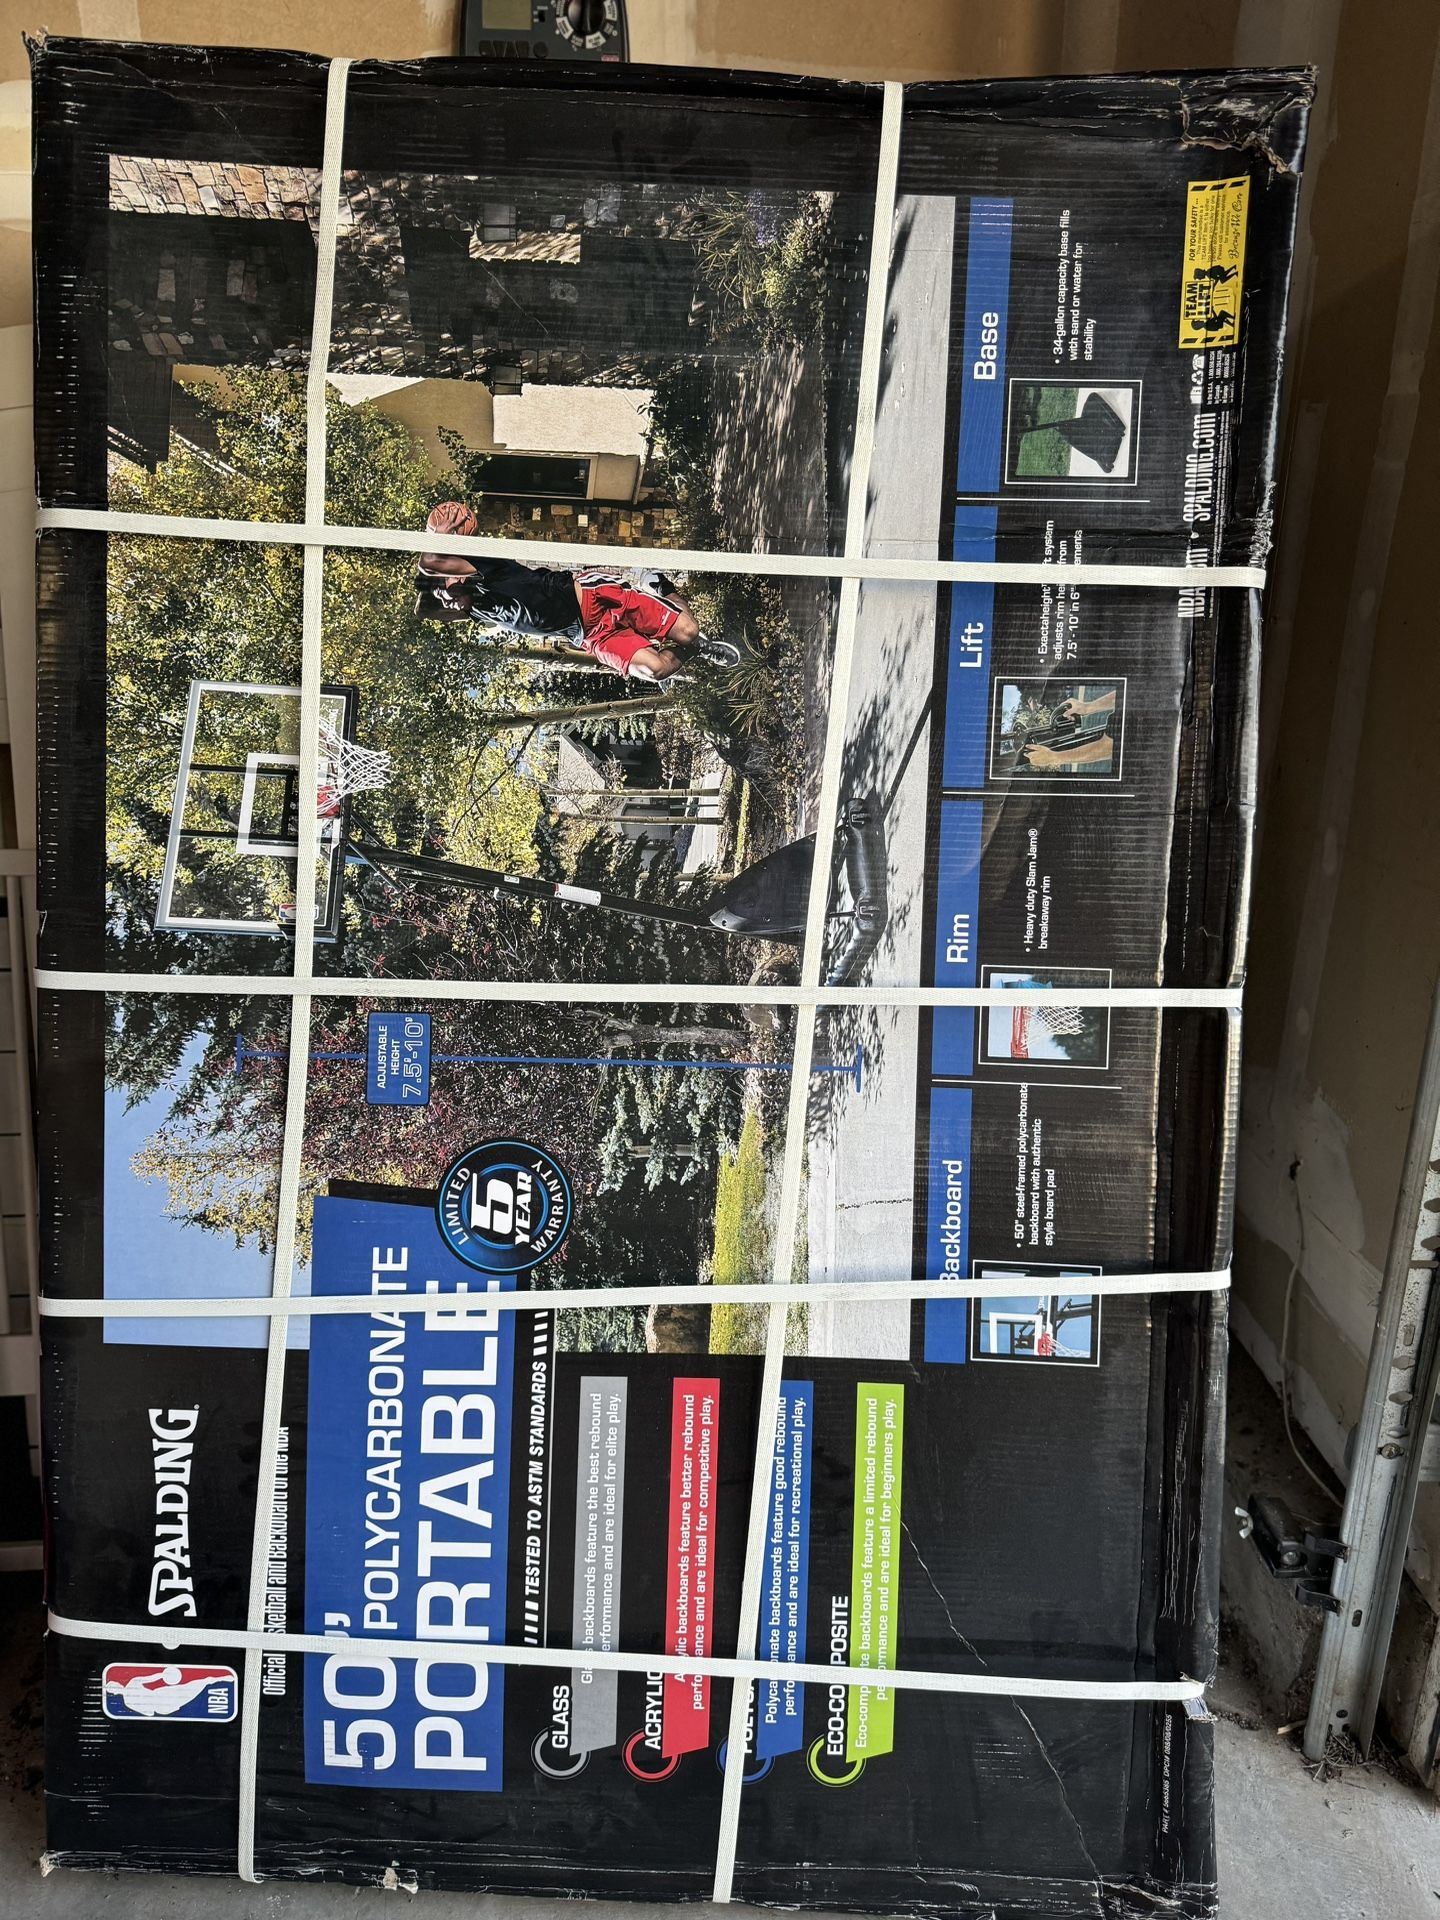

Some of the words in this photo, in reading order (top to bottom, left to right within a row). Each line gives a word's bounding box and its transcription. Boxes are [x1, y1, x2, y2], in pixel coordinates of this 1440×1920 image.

[1060, 209, 1070, 228] fills
[1058, 230, 1068, 256] base
[1073, 243, 1083, 258] for
[1055, 258, 1069, 303] capacity
[1072, 261, 1082, 293] water
[1072, 295, 1081, 307] or
[1185, 283, 1197, 318] TEAM
[1198, 284, 1211, 317] LIFT
[1052, 305, 1067, 355] 34-gallon
[1069, 309, 1079, 335] sand
[1083, 318, 1096, 360] stability
[973, 312, 998, 380] Base
[1068, 337, 1078, 360] with
[1182, 412, 1216, 521] SPALDING.com
[1044, 520, 1054, 555] system
[1057, 541, 1067, 565] from
[1056, 584, 1065, 599] hei
[1177, 548, 1208, 618] NBAom
[1055, 602, 1064, 619] rim
[1068, 614, 1078, 632] 10'
[1070, 602, 1079, 611] in
[960, 622, 984, 667] Lift
[1053, 622, 1064, 660] adjusts
[1067, 640, 1077, 660] 7.5'
[1027, 828, 1038, 860] Jam®
[1026, 862, 1036, 887] Slam
[1040, 876, 1050, 893] rim
[1026, 889, 1038, 911] duty
[947, 914, 970, 963] Rim
[1024, 913, 1038, 944] Heavy
[1038, 895, 1052, 949] breakaway
[377, 1025, 389, 1088] ADJUSTABLE
[390, 1039, 400, 1075] HEIGHT
[1016, 1083, 1029, 1153] polycarbonate
[1031, 1119, 1042, 1166] authentic
[1015, 1155, 1027, 1218] steel-framed
[1030, 1168, 1040, 1190] with
[1044, 1169, 1056, 1188] pad
[445, 1167, 471, 1245] LIMITED
[470, 1172, 514, 1235] 5
[514, 1172, 532, 1245] YEAR
[530, 1160, 564, 1253] WARRANTY
[1029, 1192, 1040, 1245] backboard
[1044, 1190, 1054, 1220] board
[1014, 1220, 1026, 1239] 50"
[1044, 1222, 1056, 1246] style
[529, 1361, 547, 1456] STANDARDS
[590, 1393, 602, 1449] rebound
[606, 1393, 620, 1423] play.
[682, 1395, 694, 1451] rebound
[698, 1395, 712, 1424] play.
[775, 1397, 786, 1452] rebound
[791, 1398, 805, 1427] play.
[865, 1398, 877, 1454] rebound
[882, 1399, 896, 1428] play.
[364, 1247, 408, 1629] POLYCARBONATE
[606, 1427, 617, 1456] elite
[528, 1461, 543, 1505] ASTM
[588, 1453, 600, 1484] best
[604, 1460, 616, 1480] for
[680, 1454, 693, 1498] better
[697, 1428, 712, 1508] competitive
[773, 1456, 787, 1489] good
[790, 1431, 803, 1514] recreational
[863, 1457, 876, 1503] limited
[881, 1432, 895, 1498] beginners
[148, 1408, 199, 1616] SPALDING
[587, 1487, 599, 1509] the
[604, 1484, 616, 1515] ideal
[879, 1502, 891, 1522] for
[414, 1280, 500, 1771] PORTABLE
[527, 1510, 542, 1530] TO
[605, 1519, 615, 1541] are
[678, 1502, 691, 1552] feature
[696, 1511, 708, 1532] for
[770, 1492, 784, 1543] feature
[788, 1517, 800, 1537] for
[584, 1513, 598, 1563] feature
[694, 1535, 707, 1566] ideal
[787, 1541, 800, 1572] ideal
[861, 1519, 874, 1568] feature
[878, 1526, 891, 1557] ideal
[266, 1562, 287, 1584] and
[525, 1536, 541, 1596] TESTED
[601, 1545, 614, 1569] and
[880, 1561, 890, 1583] are
[675, 1556, 689, 1634] backboards
[697, 1570, 706, 1593] are
[768, 1547, 782, 1625] backboards
[789, 1576, 799, 1599] are
[877, 1587, 889, 1611] and
[262, 1587, 287, 1650] sketball
[582, 1567, 596, 1644] backboards
[600, 1574, 613, 1651] erformance
[694, 1597, 705, 1622] and
[786, 1602, 798, 1627] and
[859, 1572, 873, 1649] backboards
[262, 1654, 286, 1695] Official
[674, 1637, 689, 1682] Aylic
[691, 1625, 705, 1710] perfoance
[784, 1631, 797, 1715] perfoance
[827, 1595, 848, 1756] ECO-COPOSITE
[876, 1615, 888, 1700] peormance
[765, 1629, 780, 1724] Polycanate
[208, 1687, 228, 1713] NBA
[552, 1685, 570, 1749] GLASS
[645, 1671, 663, 1750] ACRYLIC
[856, 1654, 872, 1748] Eco-compte
